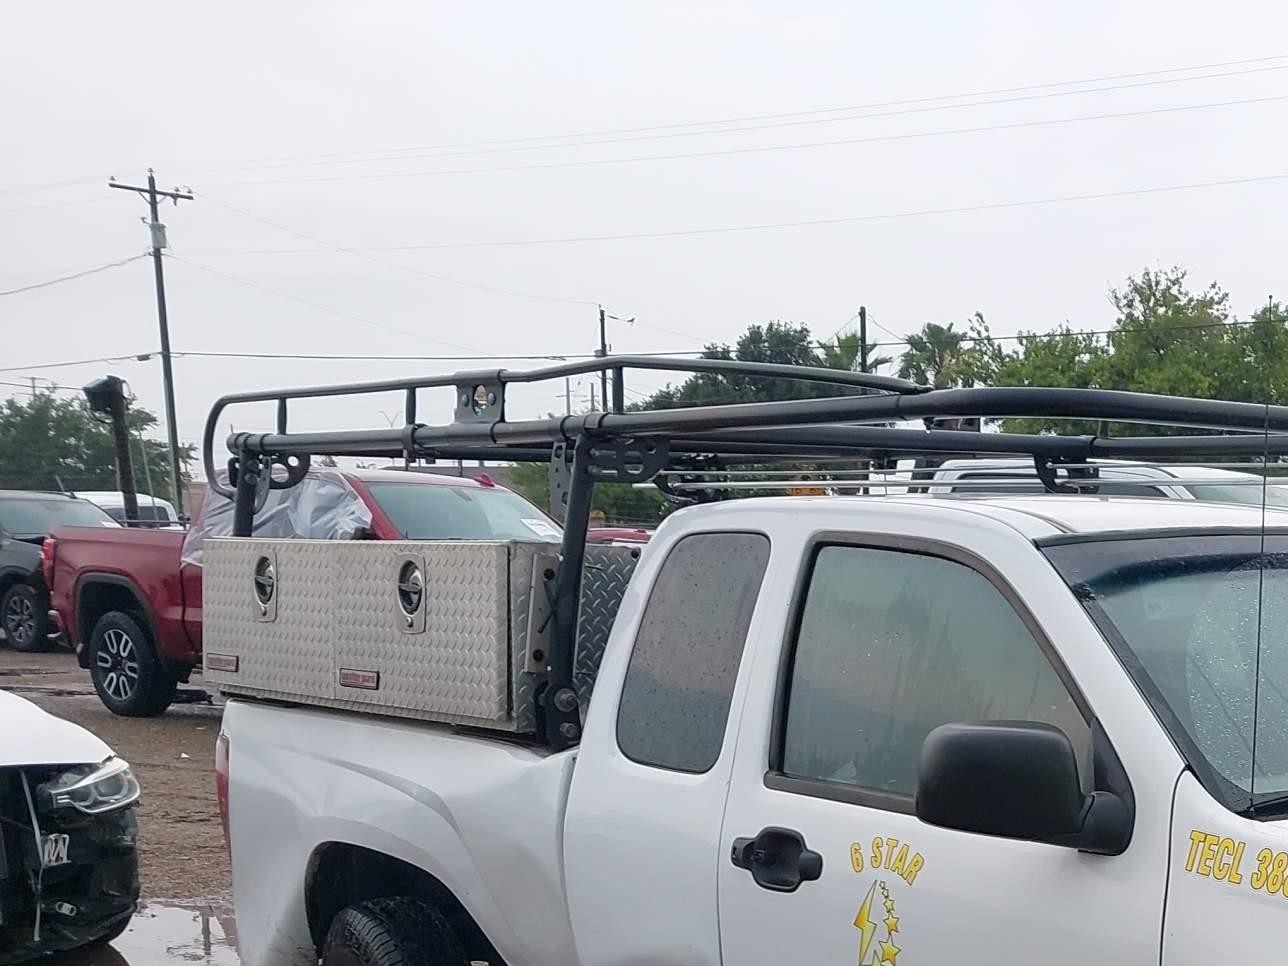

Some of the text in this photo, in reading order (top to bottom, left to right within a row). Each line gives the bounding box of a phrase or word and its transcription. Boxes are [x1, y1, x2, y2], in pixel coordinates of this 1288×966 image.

[850, 836, 925, 886] 6 STAR
[1185, 830, 1246, 884] TECL
